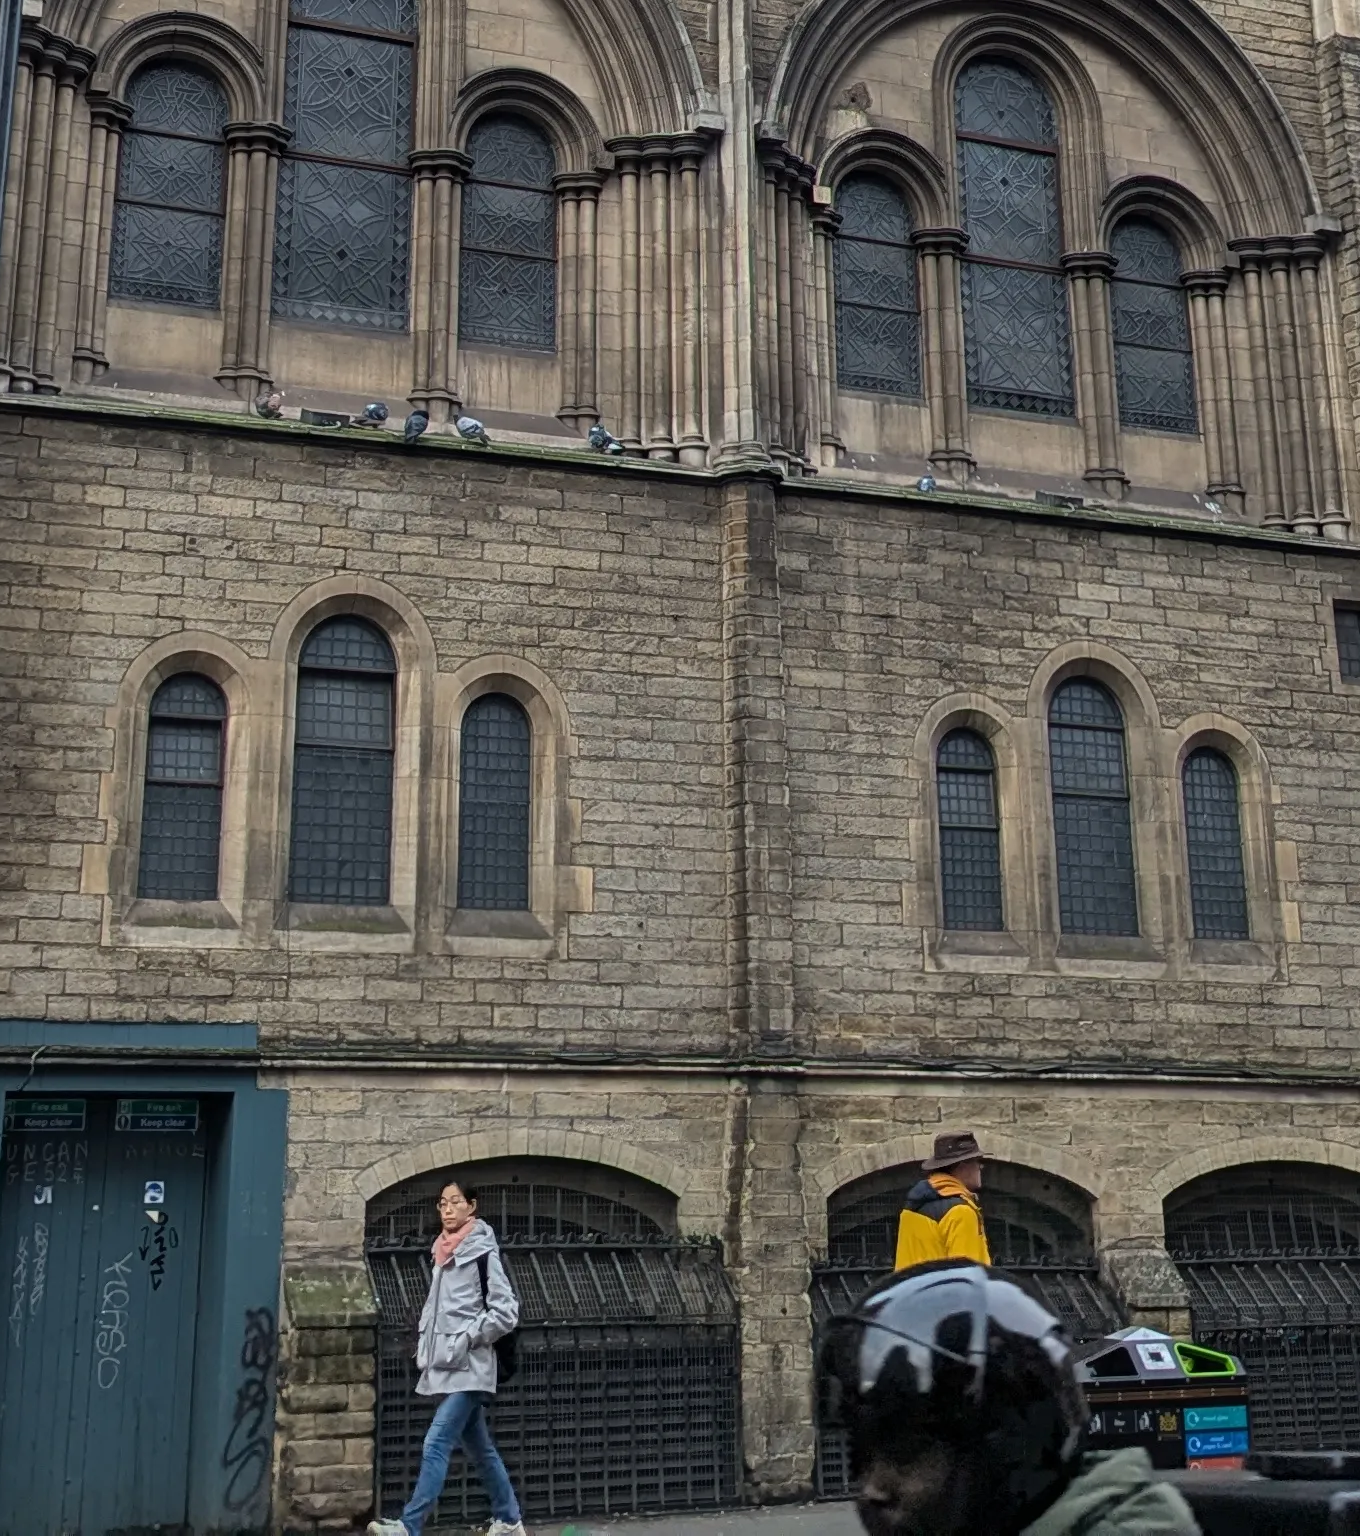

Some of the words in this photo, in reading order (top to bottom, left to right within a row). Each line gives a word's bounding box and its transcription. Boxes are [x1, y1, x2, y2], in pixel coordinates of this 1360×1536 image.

[31, 1103, 49, 1112] Fire
[51, 1103, 68, 1112] exit
[147, 1103, 164, 1112] Fire
[166, 1103, 182, 1112] exit
[25, 1118, 47, 1127] Keep
[50, 1117, 72, 1126] clear
[140, 1118, 163, 1127] Keep
[165, 1118, 186, 1127] clear
